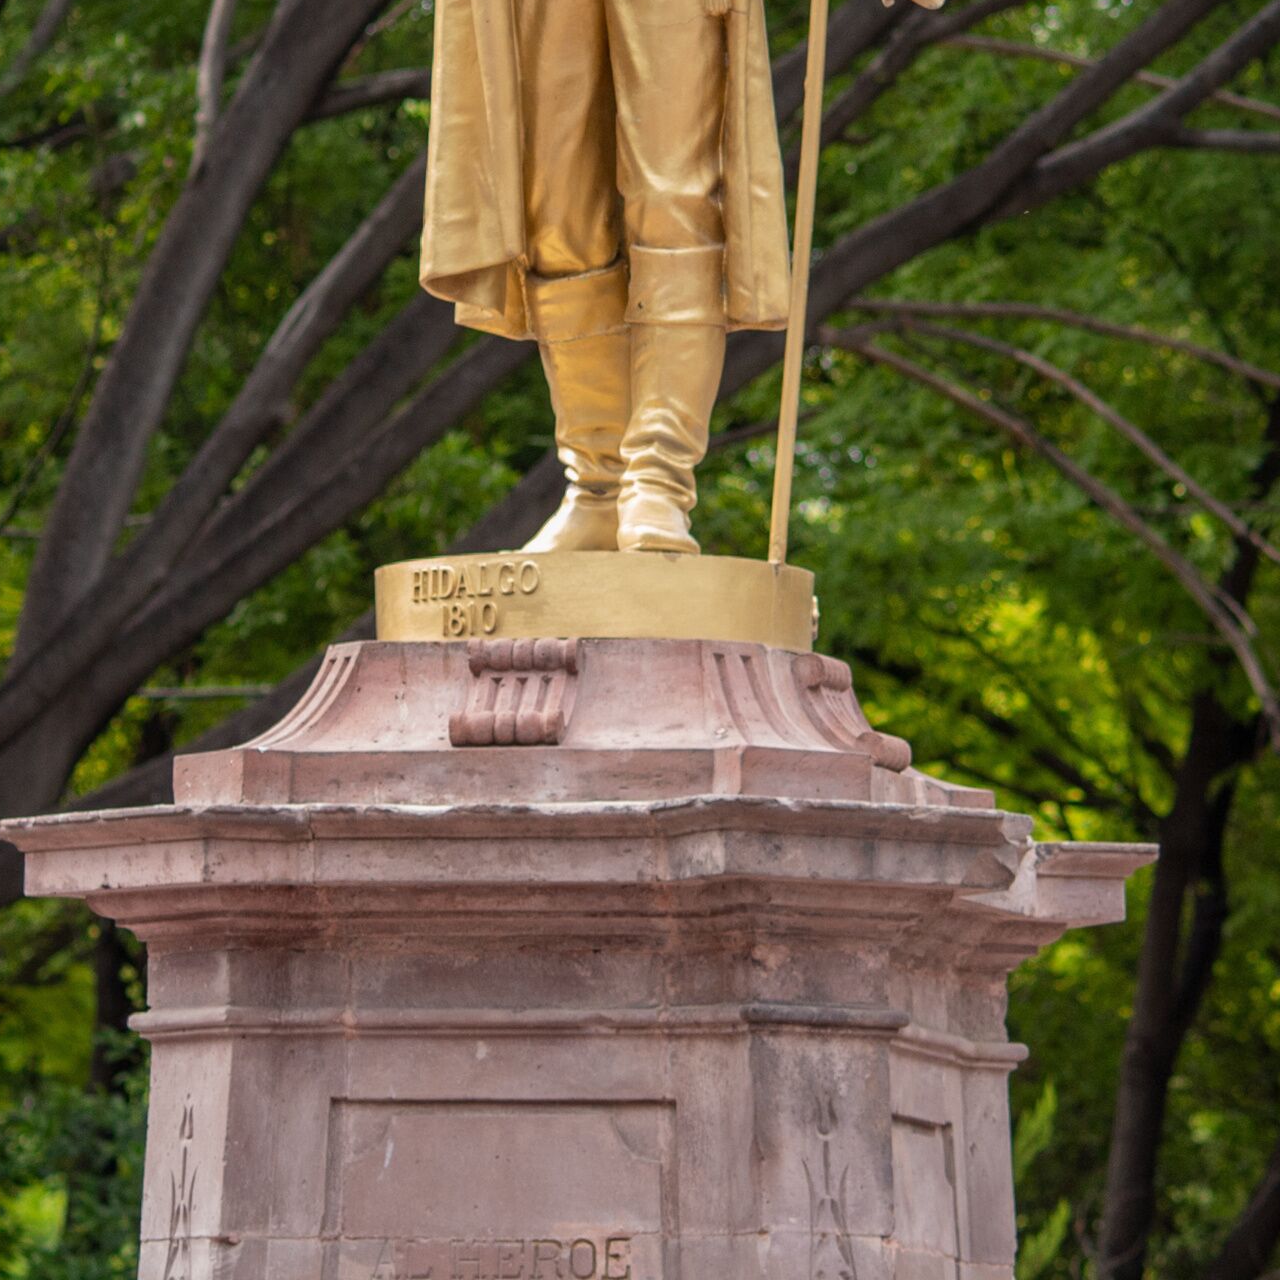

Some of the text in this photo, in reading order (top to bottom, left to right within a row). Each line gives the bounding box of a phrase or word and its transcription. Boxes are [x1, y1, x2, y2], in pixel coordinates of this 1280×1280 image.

[411, 560, 540, 603] HIDALGO
[441, 601, 497, 637] 1810
[450, 1237, 631, 1279] HEROE
